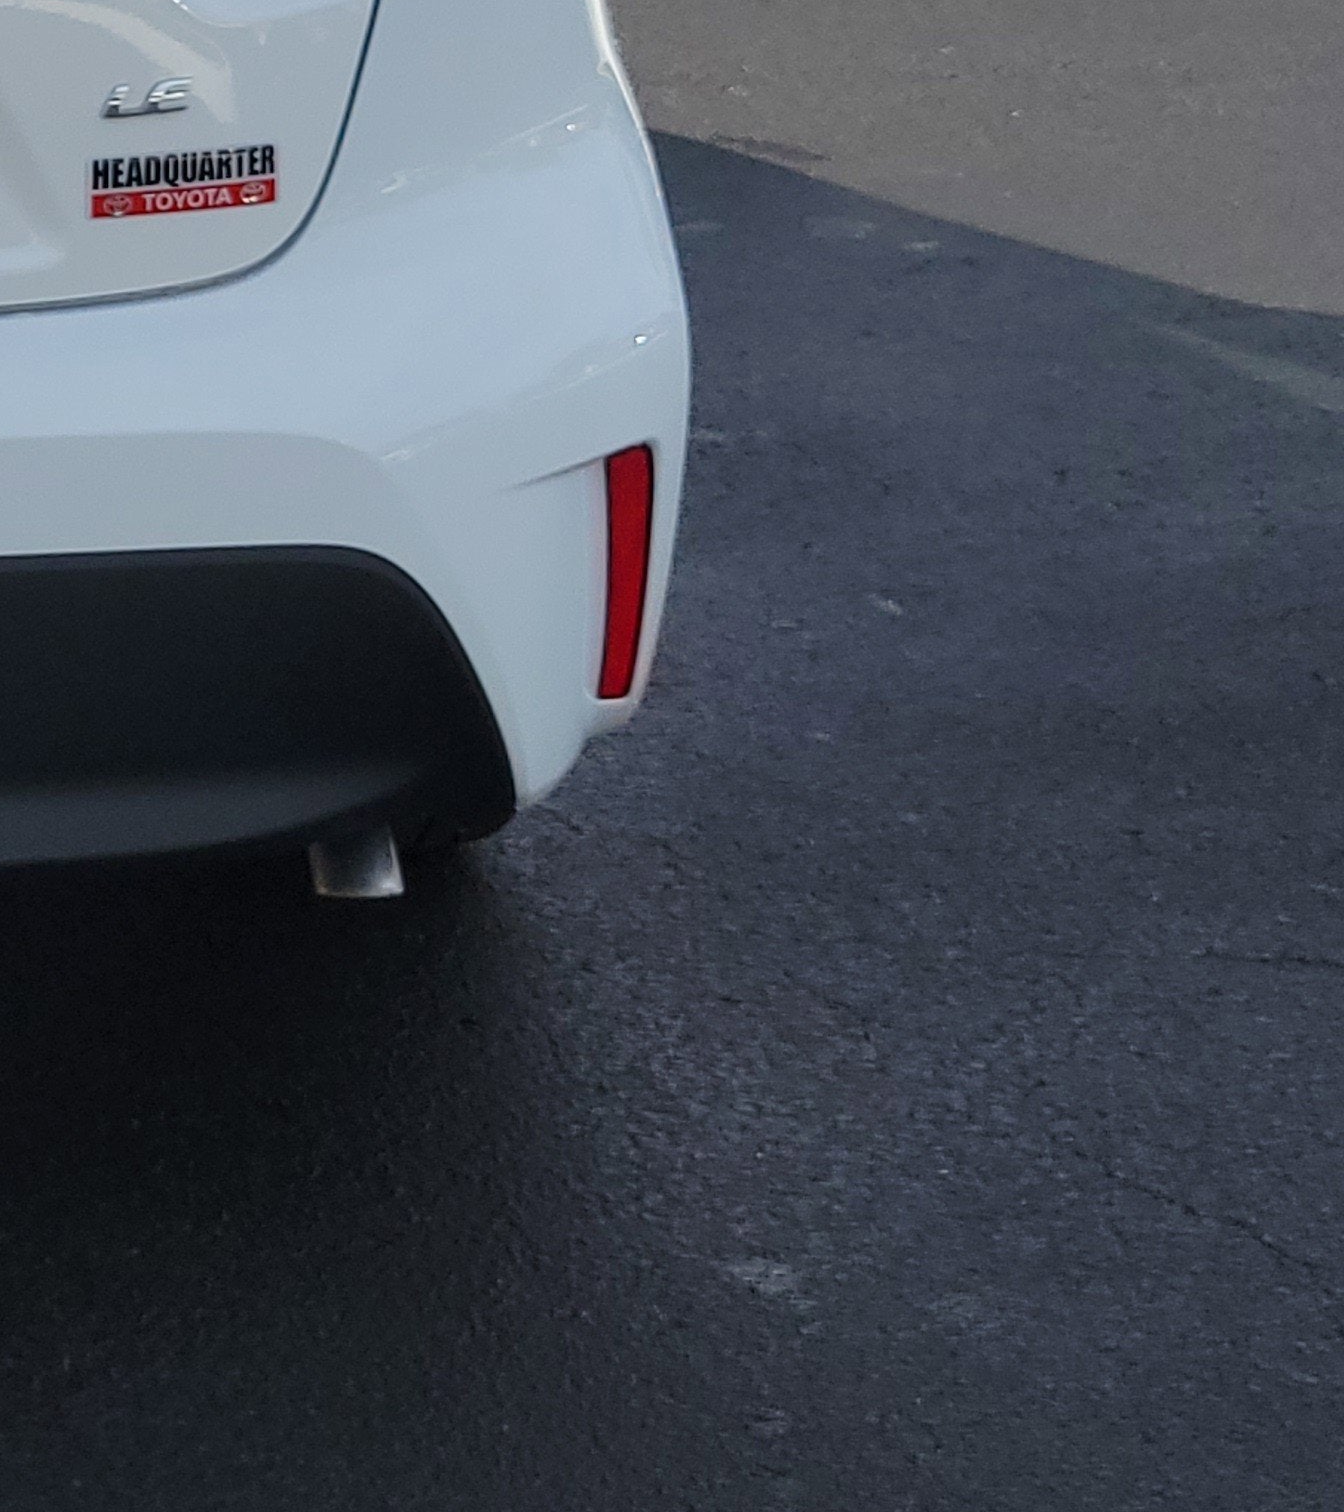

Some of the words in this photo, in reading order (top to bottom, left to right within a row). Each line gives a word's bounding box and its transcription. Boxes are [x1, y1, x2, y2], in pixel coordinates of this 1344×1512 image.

[101, 76, 194, 119] LE
[91, 144, 276, 191] HEADQUARTER
[142, 188, 233, 212] TOYOTA
